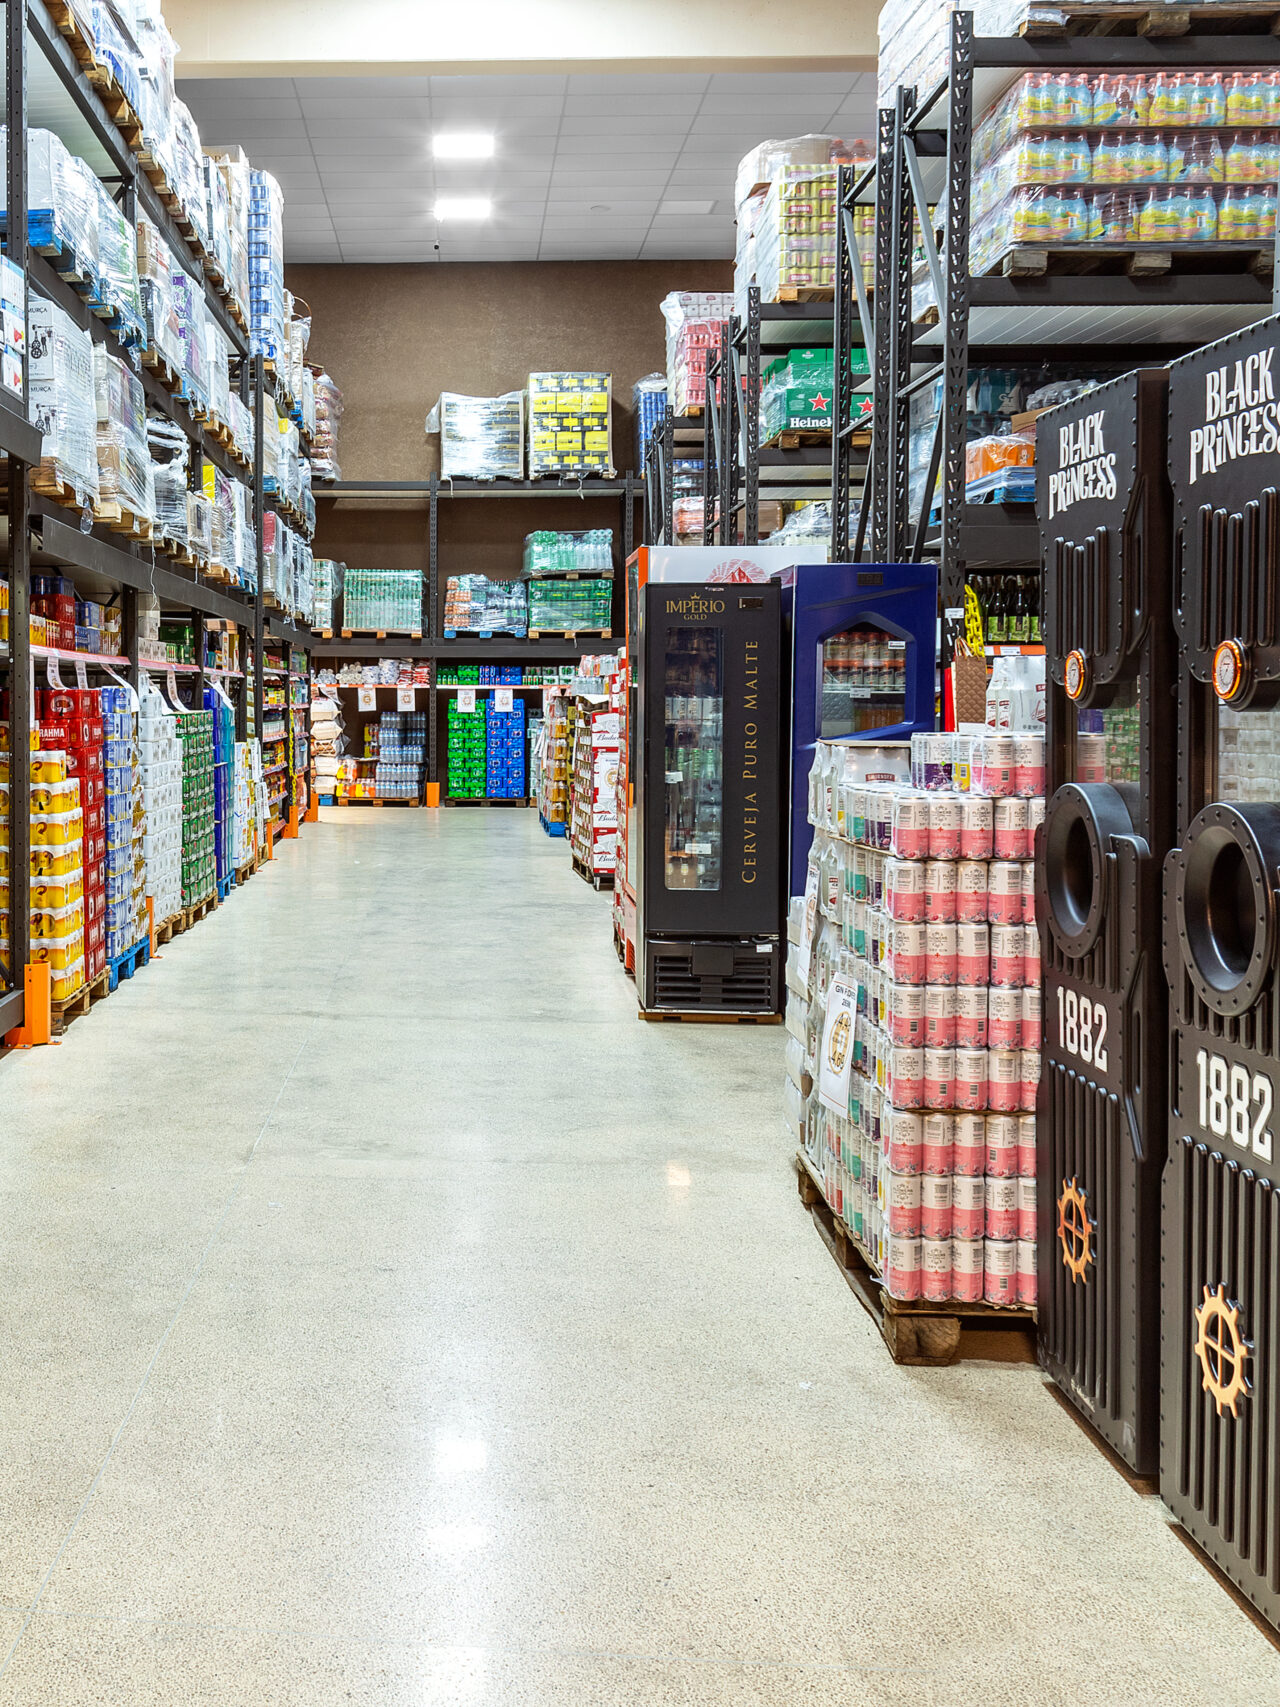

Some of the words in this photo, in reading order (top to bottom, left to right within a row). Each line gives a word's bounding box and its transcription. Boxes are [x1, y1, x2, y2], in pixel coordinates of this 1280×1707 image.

[1206, 346, 1275, 423] BLACK
[790, 417, 833, 428] Heinek
[1059, 409, 1106, 469] BLACK
[744, 640, 758, 710] MALTE
[742, 723, 758, 779] PURO
[741, 792, 758, 884] CERVEJA
[1056, 985, 1108, 1074] 1882
[1196, 1049, 1273, 1164] 1882
